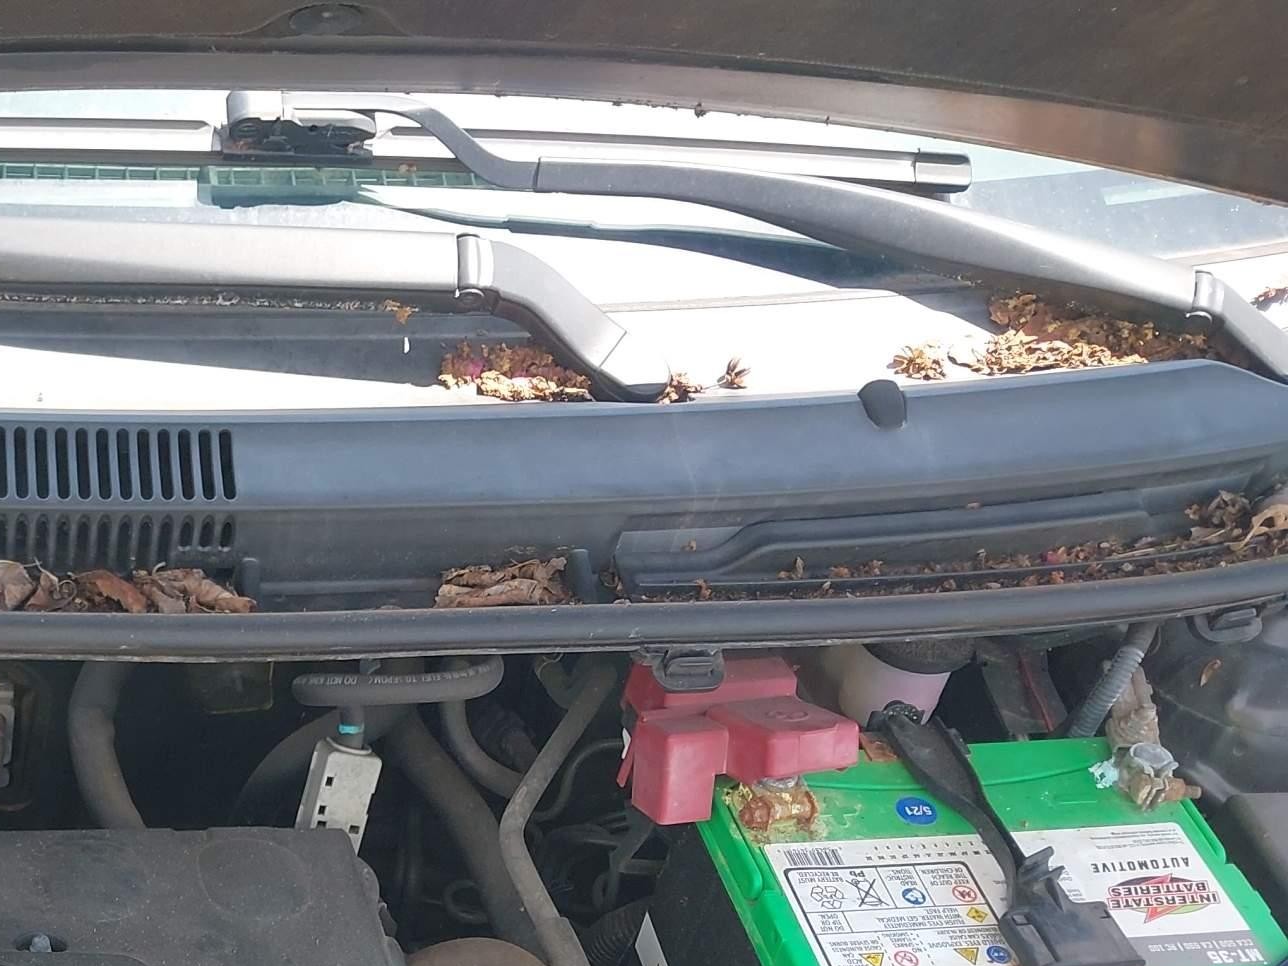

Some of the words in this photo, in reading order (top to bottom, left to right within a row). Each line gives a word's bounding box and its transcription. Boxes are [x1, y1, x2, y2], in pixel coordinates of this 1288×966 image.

[905, 805, 932, 815] 5/21
[1091, 857, 1189, 873] AUTOMOTIVE
[1111, 882, 1207, 896] BATTERIES
[1110, 894, 1217, 908] INTERSTATE
[1206, 948, 1264, 964] MT-35
